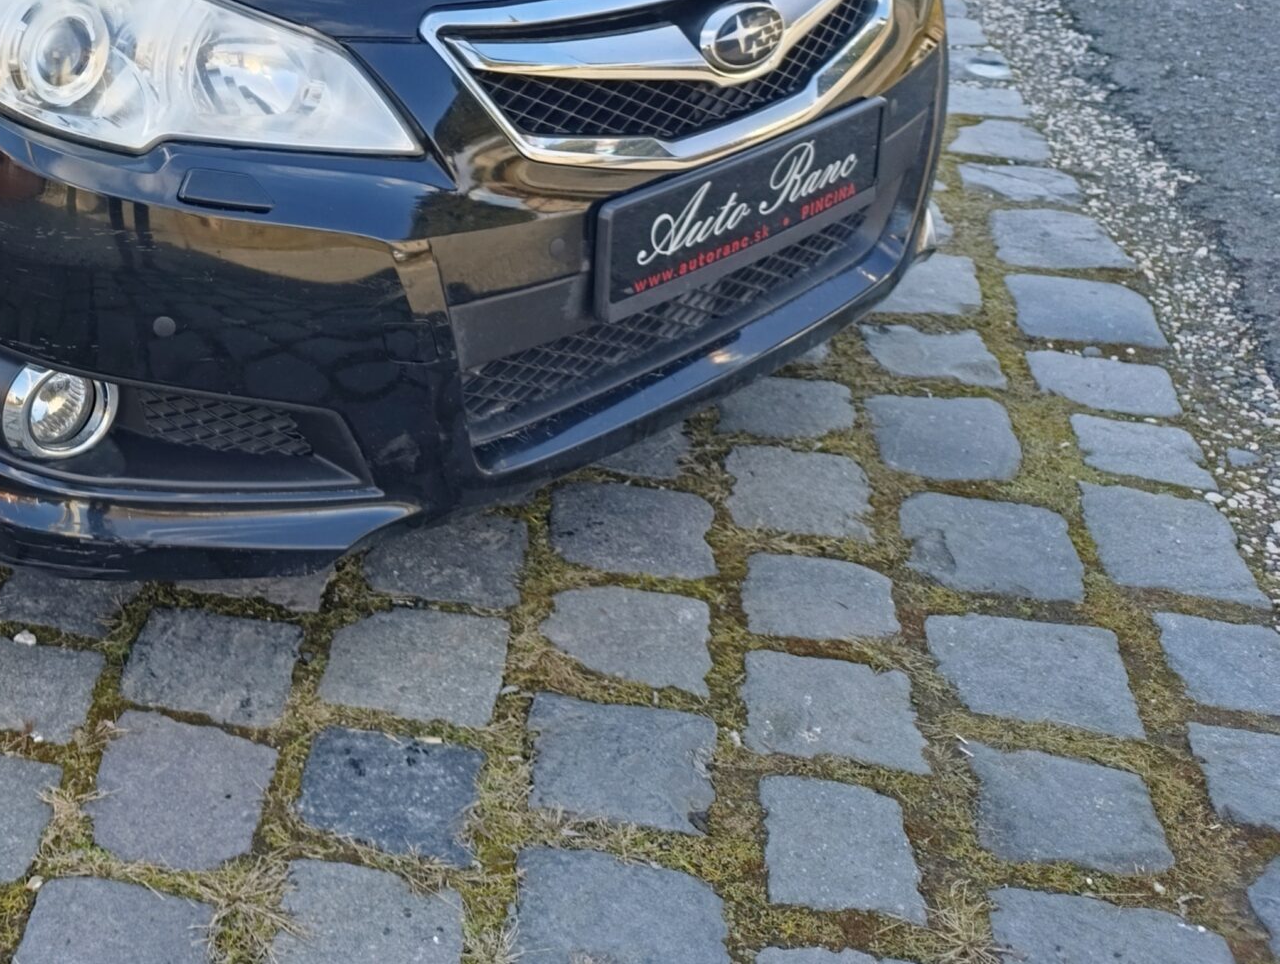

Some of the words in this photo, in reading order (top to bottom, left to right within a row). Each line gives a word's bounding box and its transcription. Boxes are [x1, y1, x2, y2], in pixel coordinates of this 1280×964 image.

[637, 181, 751, 266] Auto
[759, 140, 858, 215] Ranc
[633, 224, 769, 293] www.autoranc.sk
